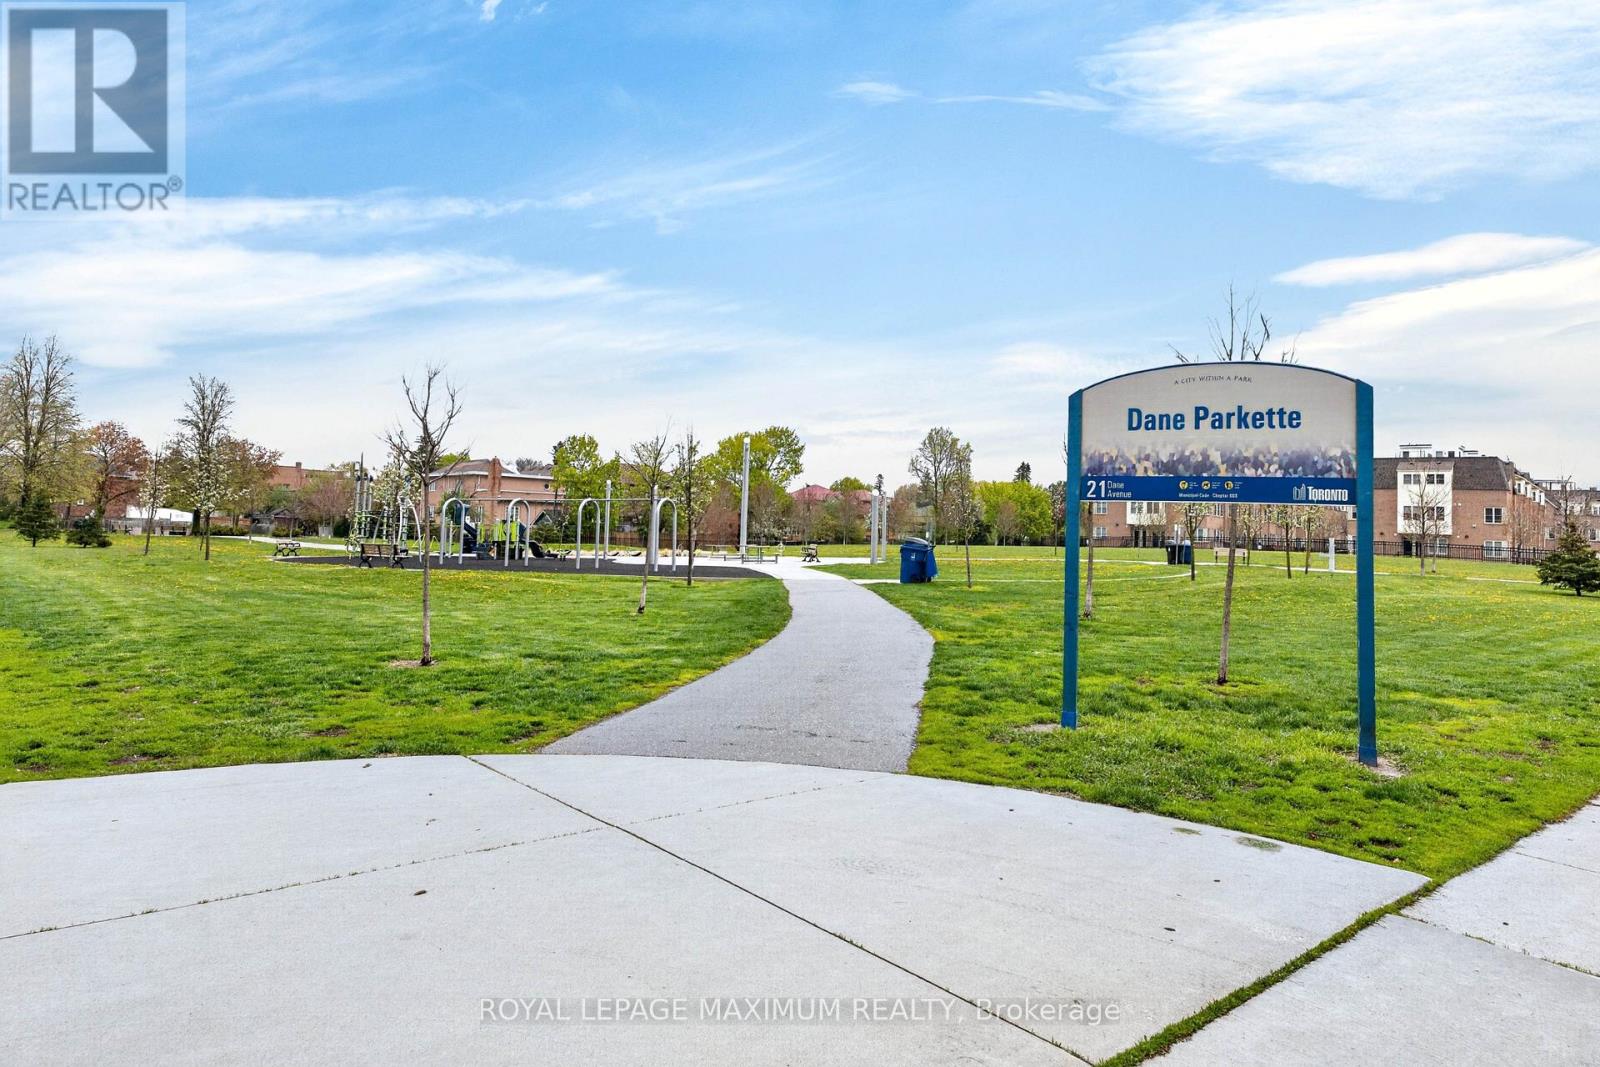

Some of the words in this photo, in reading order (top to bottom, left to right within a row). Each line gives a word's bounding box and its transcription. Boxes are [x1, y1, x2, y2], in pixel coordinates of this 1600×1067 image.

[1234, 375, 1253, 383] PARK
[1128, 407, 1185, 431] Dane
[1194, 405, 1302, 430] Parkette
[1086, 480, 1106, 498] 21
[1107, 480, 1124, 489] Dane
[1107, 490, 1132, 498] Avenue
[1307, 486, 1348, 501] TORONTO
